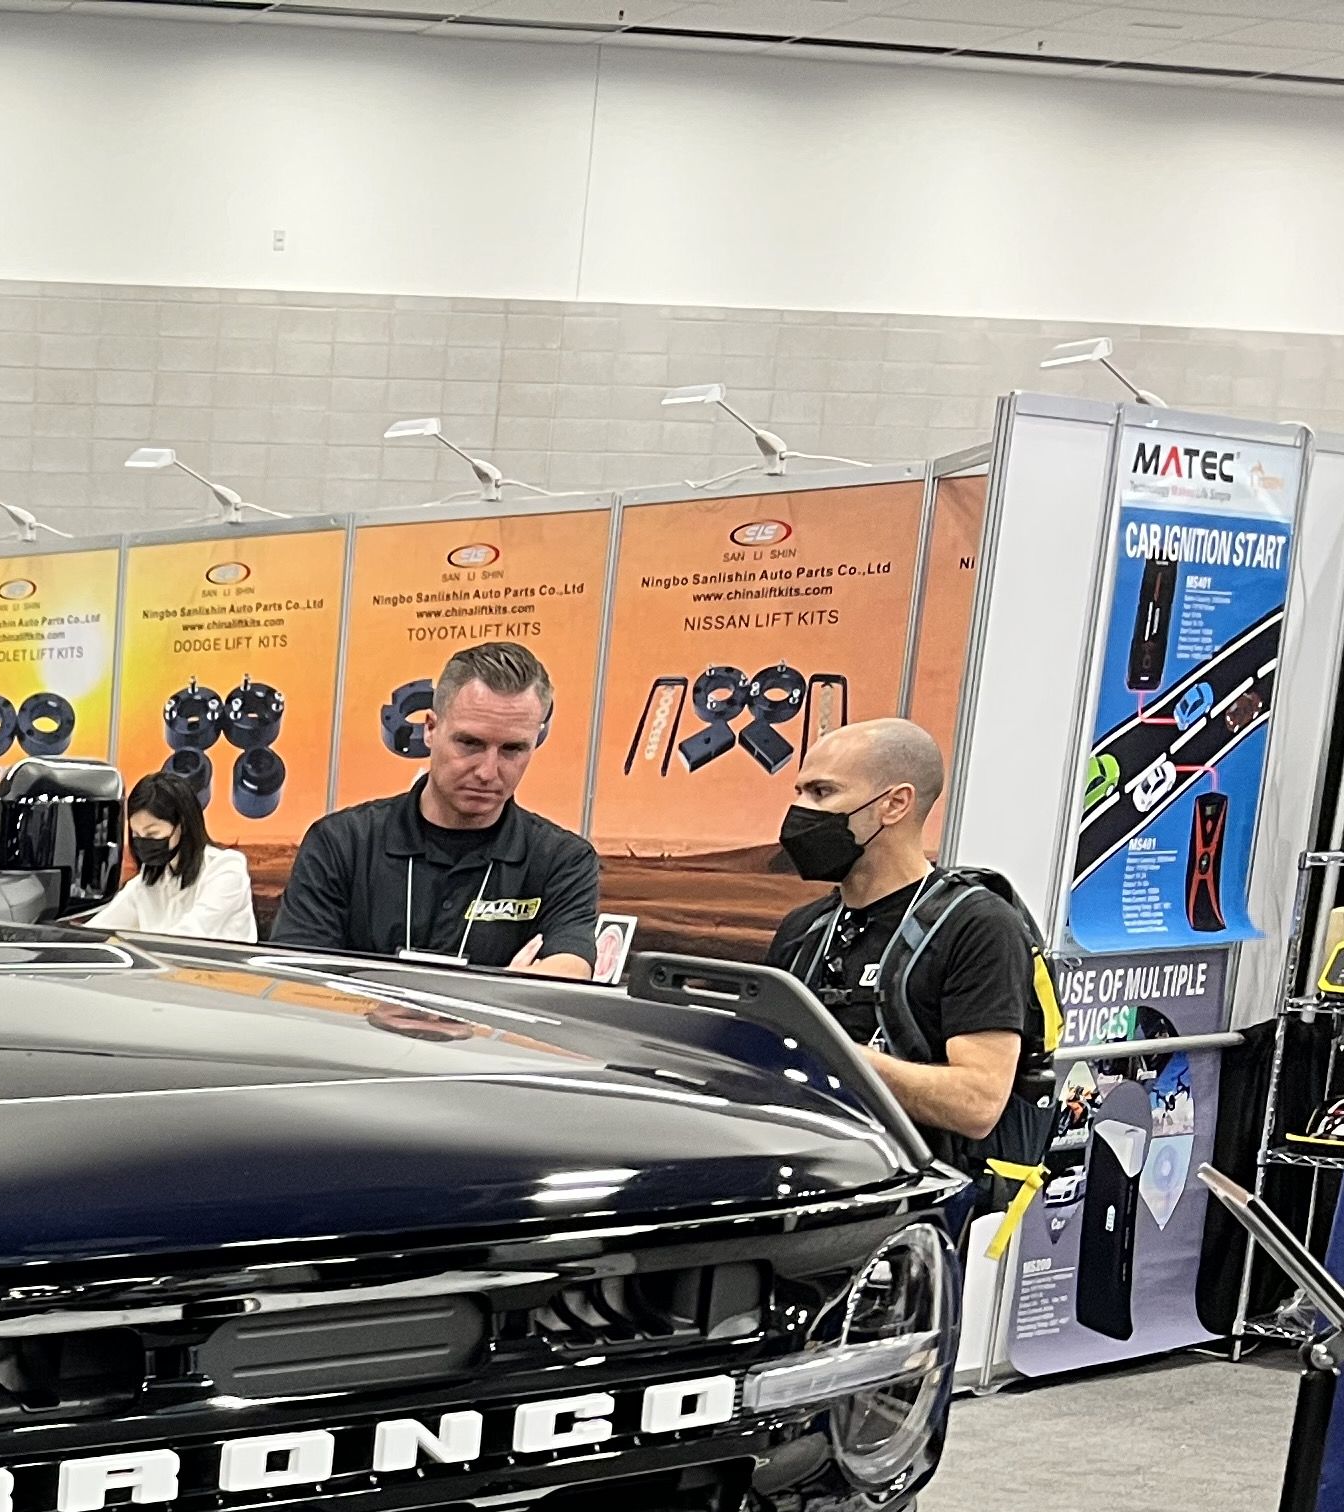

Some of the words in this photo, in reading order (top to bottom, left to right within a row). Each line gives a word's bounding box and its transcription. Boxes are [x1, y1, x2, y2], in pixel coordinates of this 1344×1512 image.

[1131, 442, 1234, 483] MATEC
[723, 551, 745, 563] SAN
[770, 548, 797, 560] SHIN
[1125, 521, 1161, 560] CAR
[1162, 525, 1233, 566] IGNITION
[1232, 531, 1287, 570] START
[481, 570, 505, 580] SHIN
[641, 574, 688, 590] Ningbo
[692, 569, 757, 585] Sanlishin
[759, 567, 793, 581] Auto
[796, 565, 834, 579] Parts
[372, 595, 413, 608] Ningbo
[416, 589, 470, 604] Sanlishin
[472, 588, 501, 600] Auto
[503, 586, 535, 598] Parts
[692, 584, 833, 603] www.chinaliftkits.com
[142, 609, 177, 621] Ningbo
[228, 603, 253, 614] Auto
[255, 602, 282, 612] Parts
[683, 615, 750, 632] NISSAN
[754, 612, 794, 628] LIFT
[798, 609, 840, 625] KITS
[407, 625, 466, 641] TOYOTA
[470, 623, 503, 639] LIFT
[505, 622, 542, 637] KITS
[29, 647, 56, 661] LIFT
[57, 645, 84, 659] KITS
[173, 638, 221, 654] DODGE
[224, 636, 253, 650] LIFT
[258, 634, 288, 648] KITS
[1058, 970, 1096, 1005] USE
[1098, 968, 1125, 1003] OF
[1123, 962, 1208, 1001] MULTIPLE
[1061, 1005, 1130, 1044] EVICES
